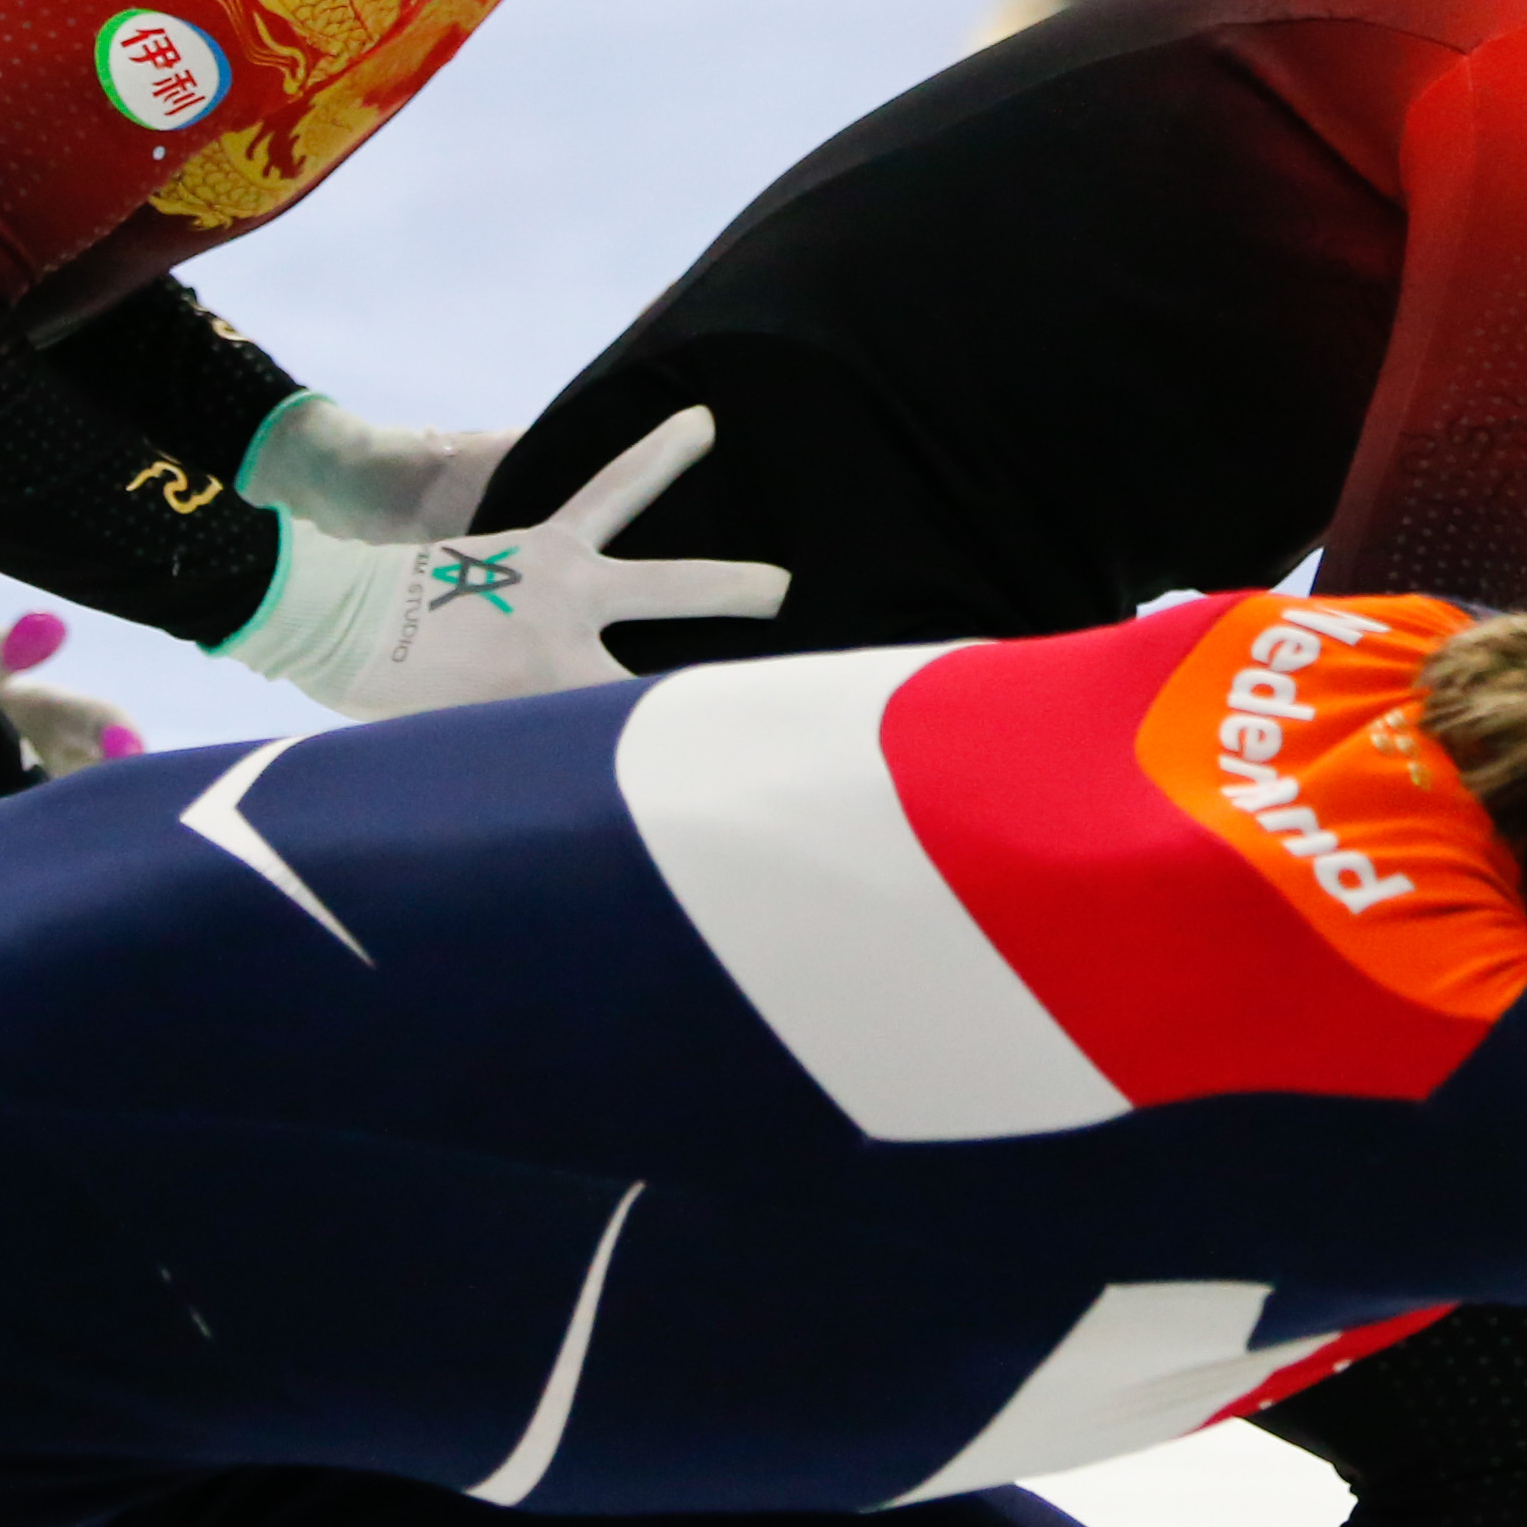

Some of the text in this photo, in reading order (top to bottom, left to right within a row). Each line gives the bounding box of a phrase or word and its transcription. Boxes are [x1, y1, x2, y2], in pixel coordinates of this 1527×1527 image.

[121, 28, 206, 116] 伊利
[391, 583, 423, 663] STUDIO
[1218, 607, 1416, 915] Nedernd
